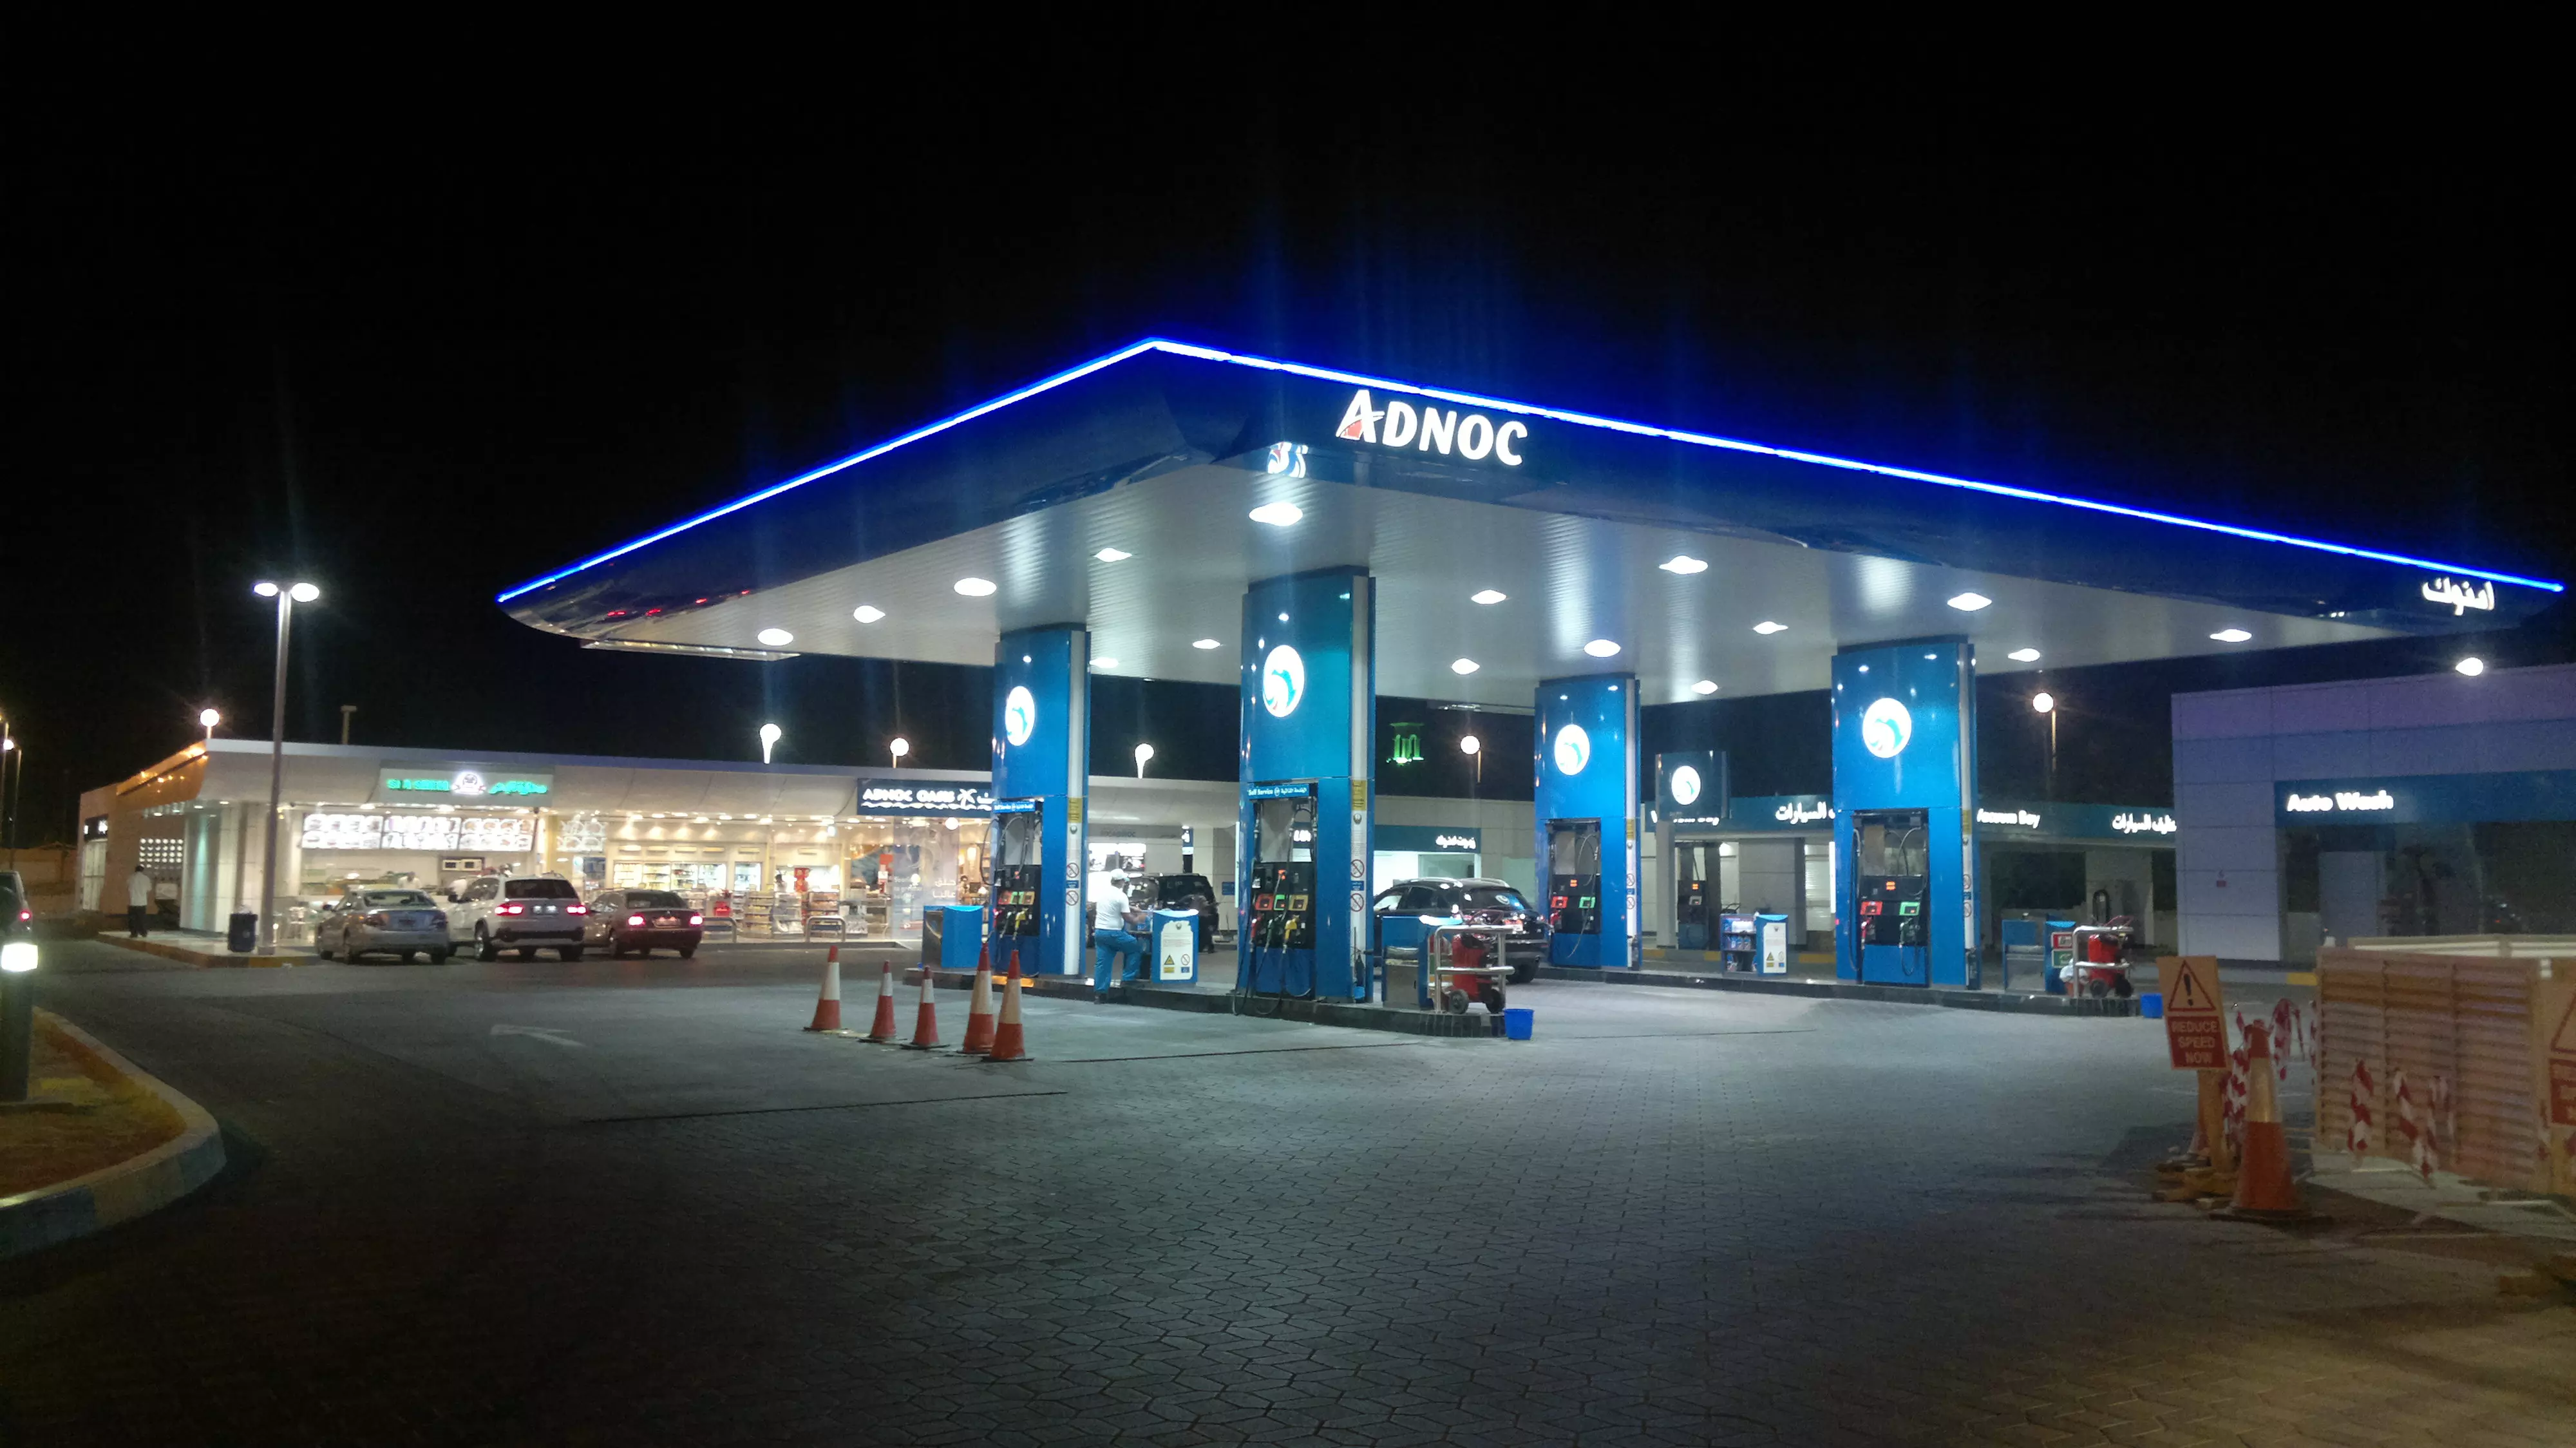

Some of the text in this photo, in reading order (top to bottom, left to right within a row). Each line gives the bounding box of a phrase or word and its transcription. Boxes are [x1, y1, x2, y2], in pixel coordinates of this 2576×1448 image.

[1336, 390, 1528, 466] ADNOC
[862, 788, 913, 802] ADNOC
[2287, 790, 2394, 812] Auto Wash
[2171, 1021, 2219, 1033] REDUCE
[2178, 1036, 2215, 1049] SPEED
[2185, 1051, 2213, 1064] NOW
